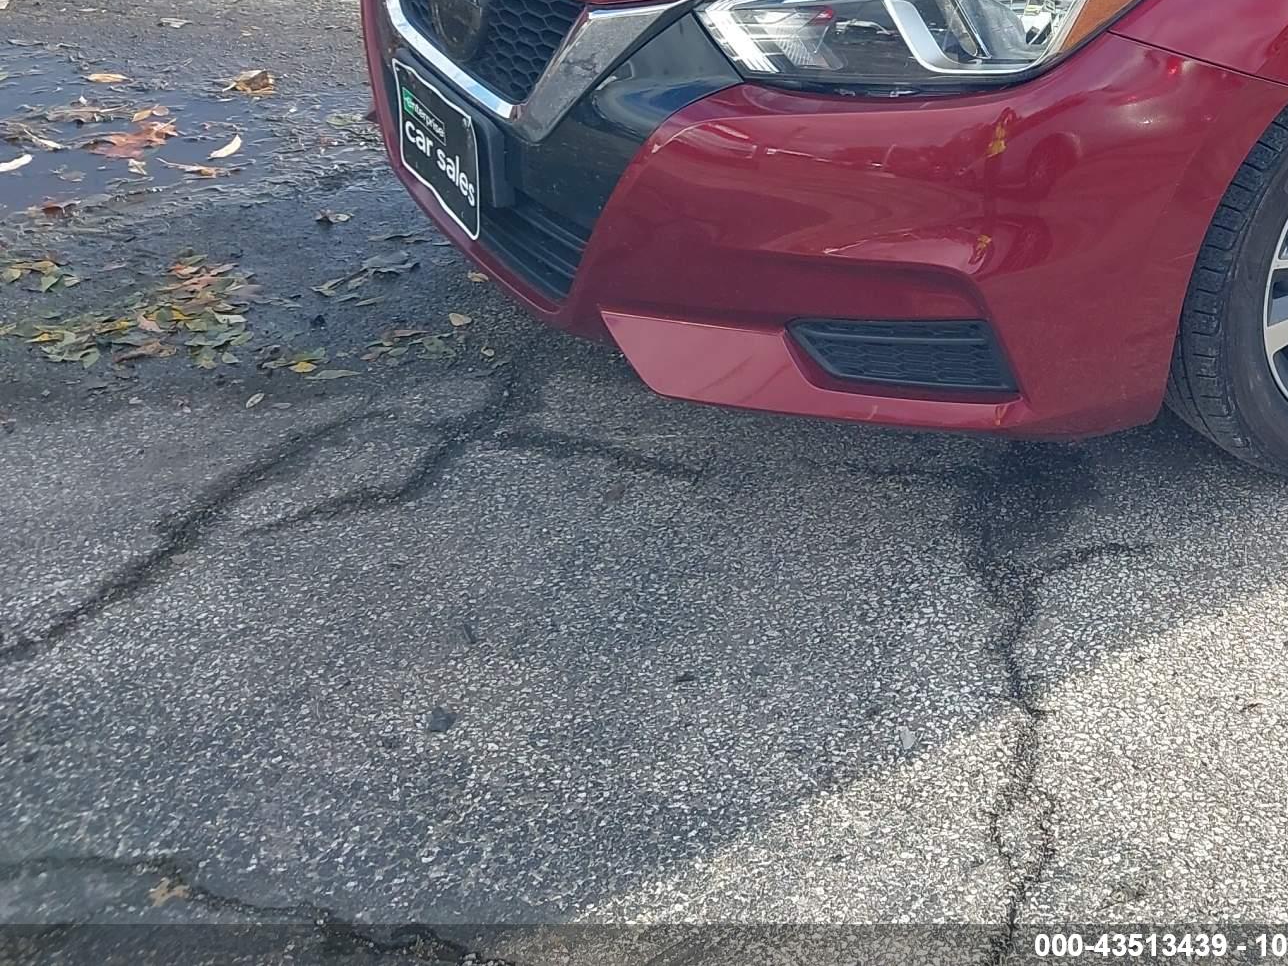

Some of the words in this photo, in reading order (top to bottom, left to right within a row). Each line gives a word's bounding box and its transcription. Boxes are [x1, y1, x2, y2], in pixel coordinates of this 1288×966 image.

[404, 95, 445, 138] enterprise
[405, 120, 433, 157] car
[436, 148, 475, 207] sales
